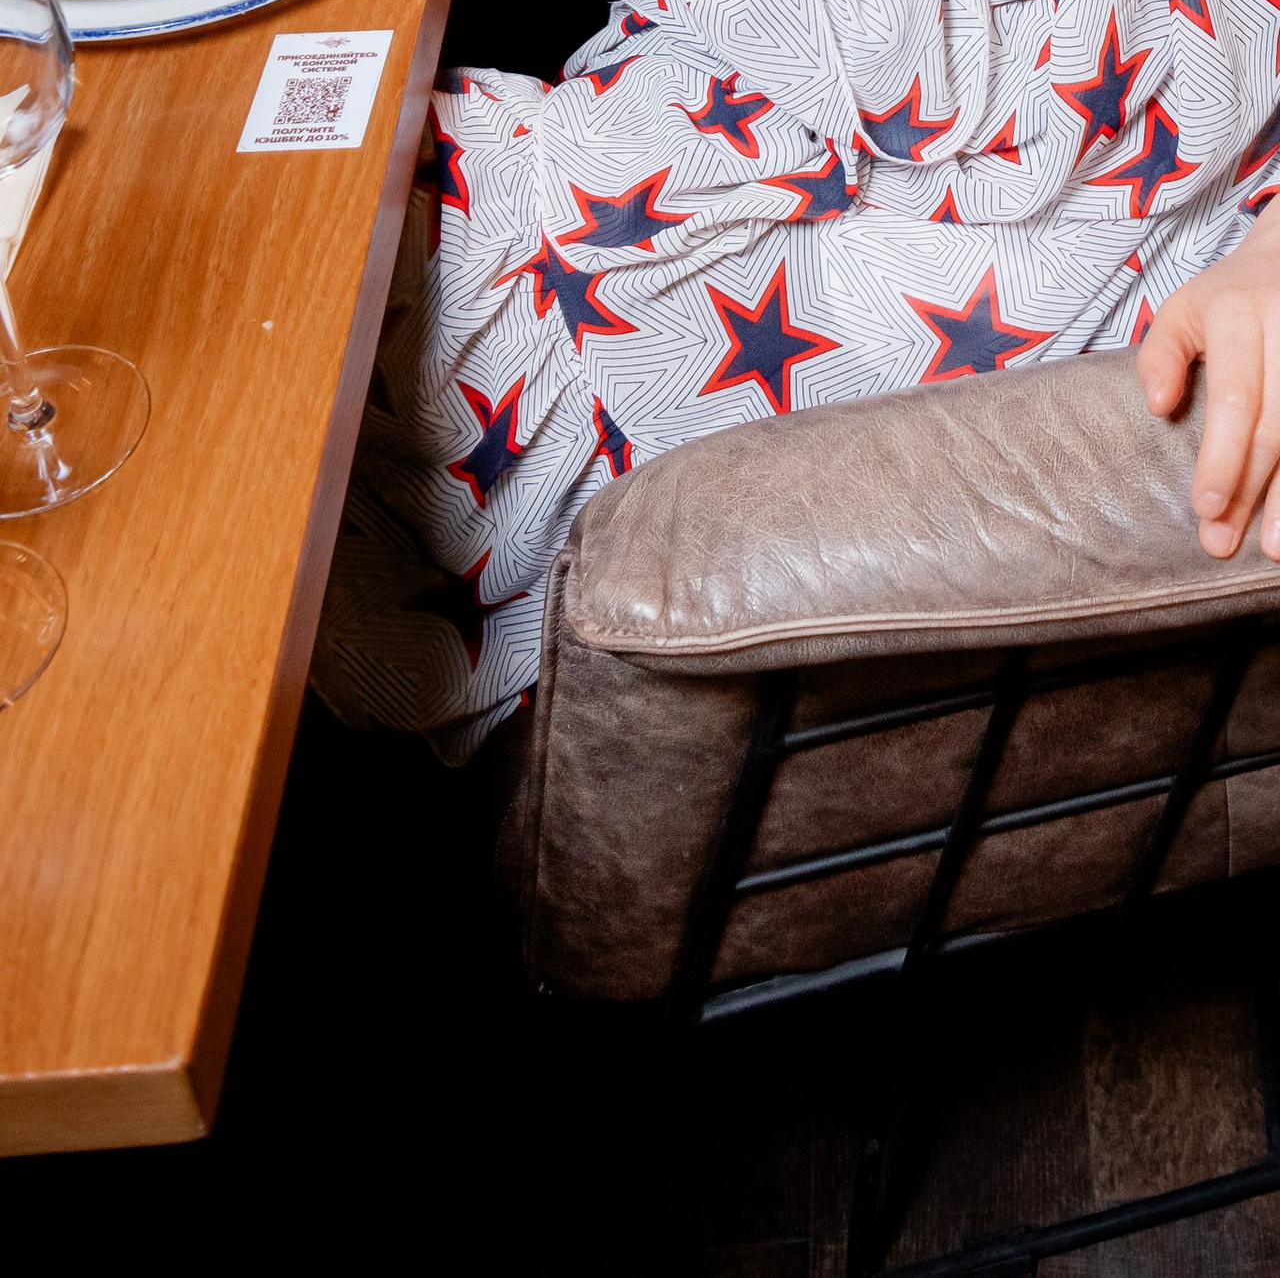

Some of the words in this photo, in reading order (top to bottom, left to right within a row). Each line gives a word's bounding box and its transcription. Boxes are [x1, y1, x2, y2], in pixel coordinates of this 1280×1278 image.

[277, 52, 378, 61] ПРИСОЕДИНЯЙТЕСЬ
[302, 58, 358, 66] БОНУСНОЙ
[272, 126, 336, 135] ПОЛУЧИТЕ
[254, 136, 304, 144] КЭШБЕК
[304, 134, 323, 143] ДО
[325, 133, 349, 141] 10%
